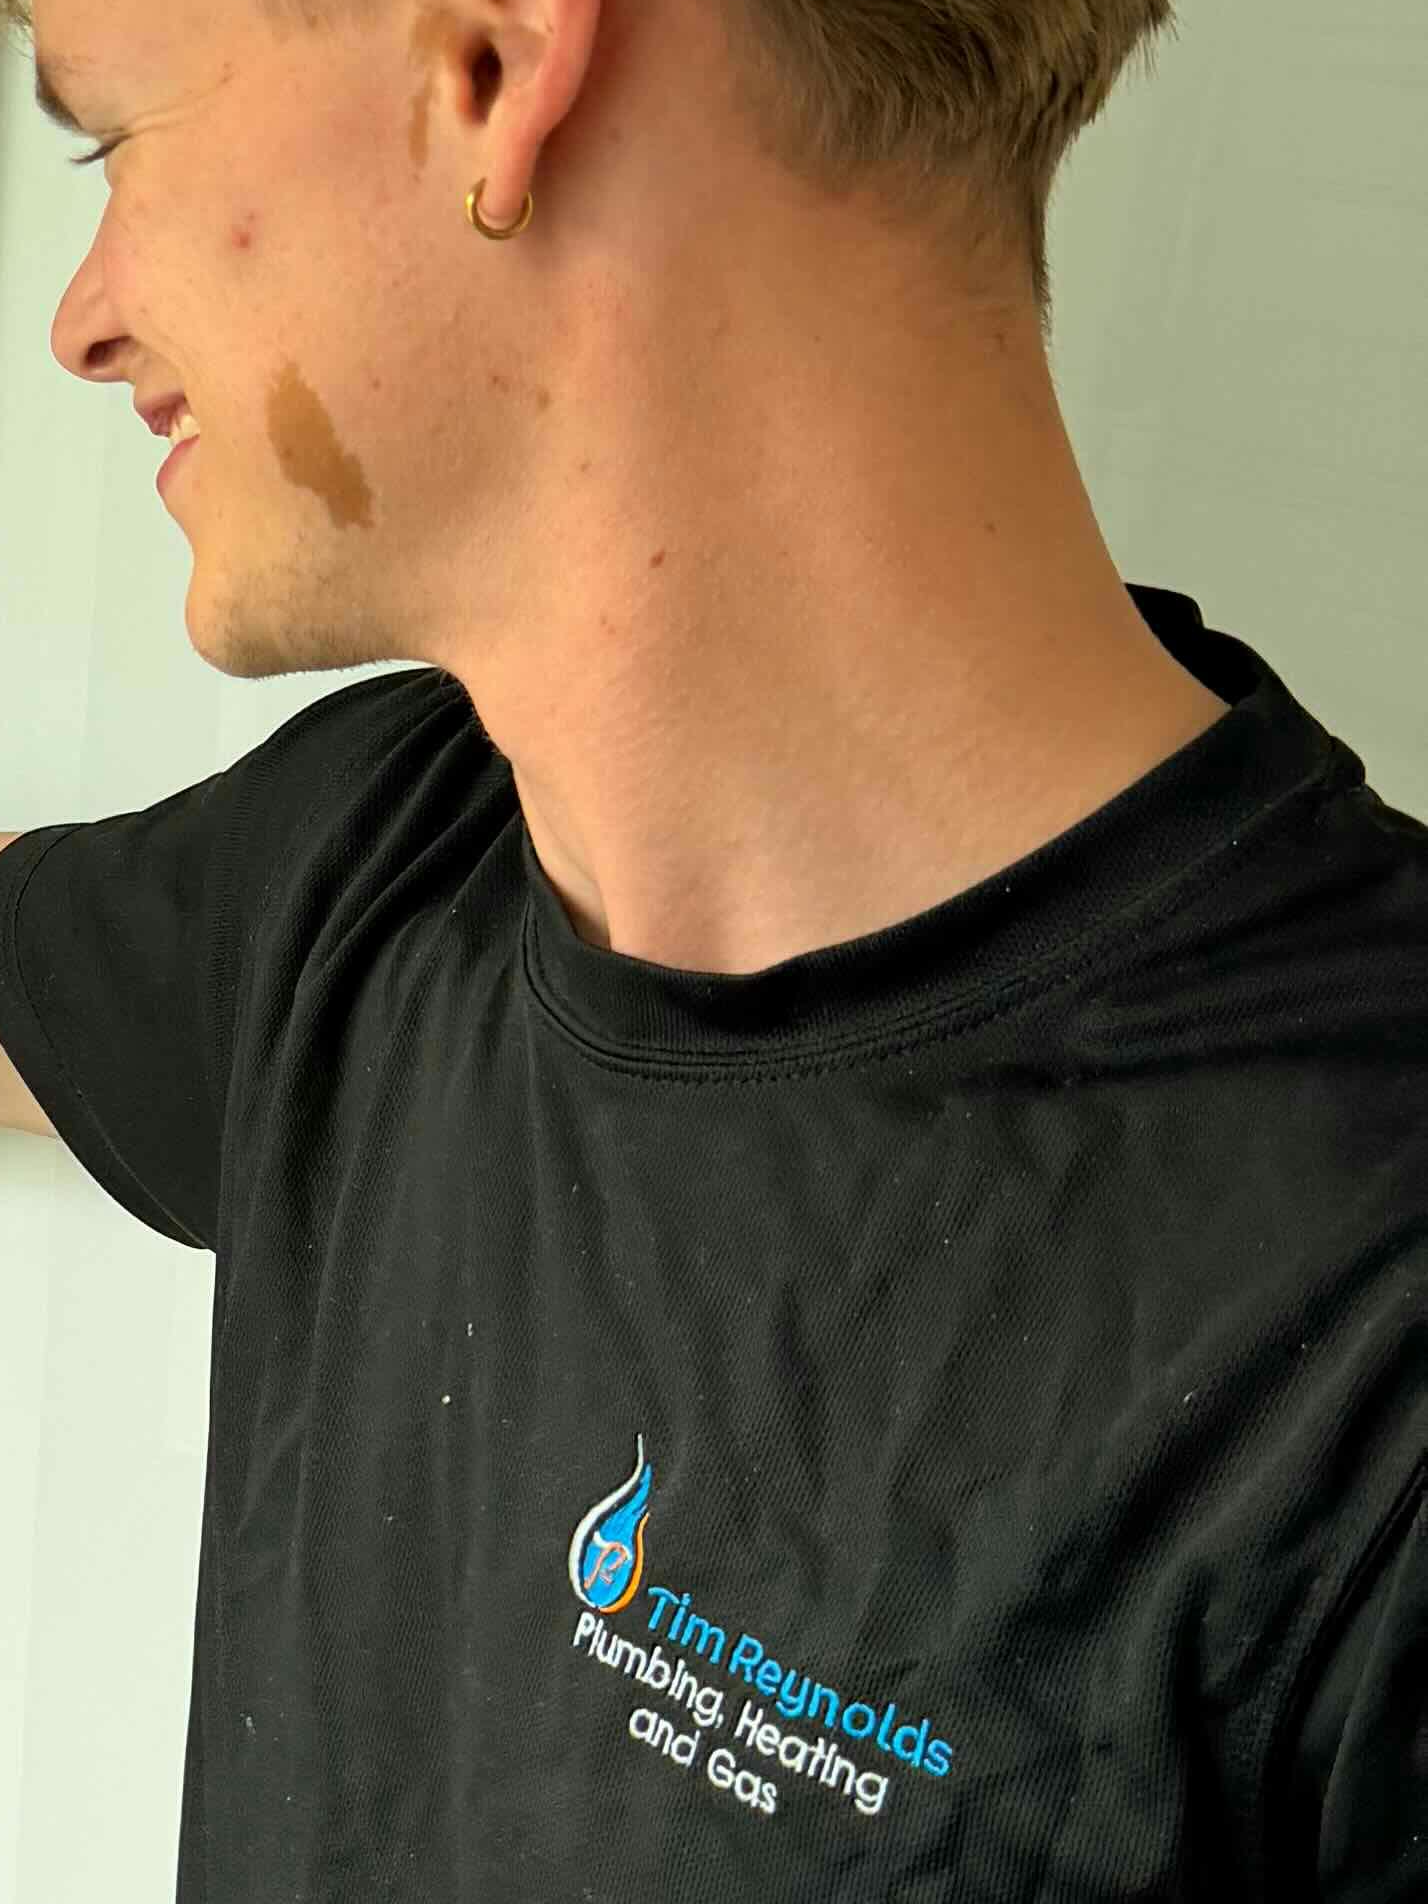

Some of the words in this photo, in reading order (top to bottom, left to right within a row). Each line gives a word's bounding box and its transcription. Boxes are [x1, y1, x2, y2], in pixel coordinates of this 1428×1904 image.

[573, 1611, 725, 1729] Plumbing,
[735, 1700, 889, 1815] Heating
[629, 1707, 700, 1766] and
[707, 1748, 778, 1814] Gas
[647, 1587, 727, 1664] Tim
[728, 1633, 954, 1777] Reynolds
